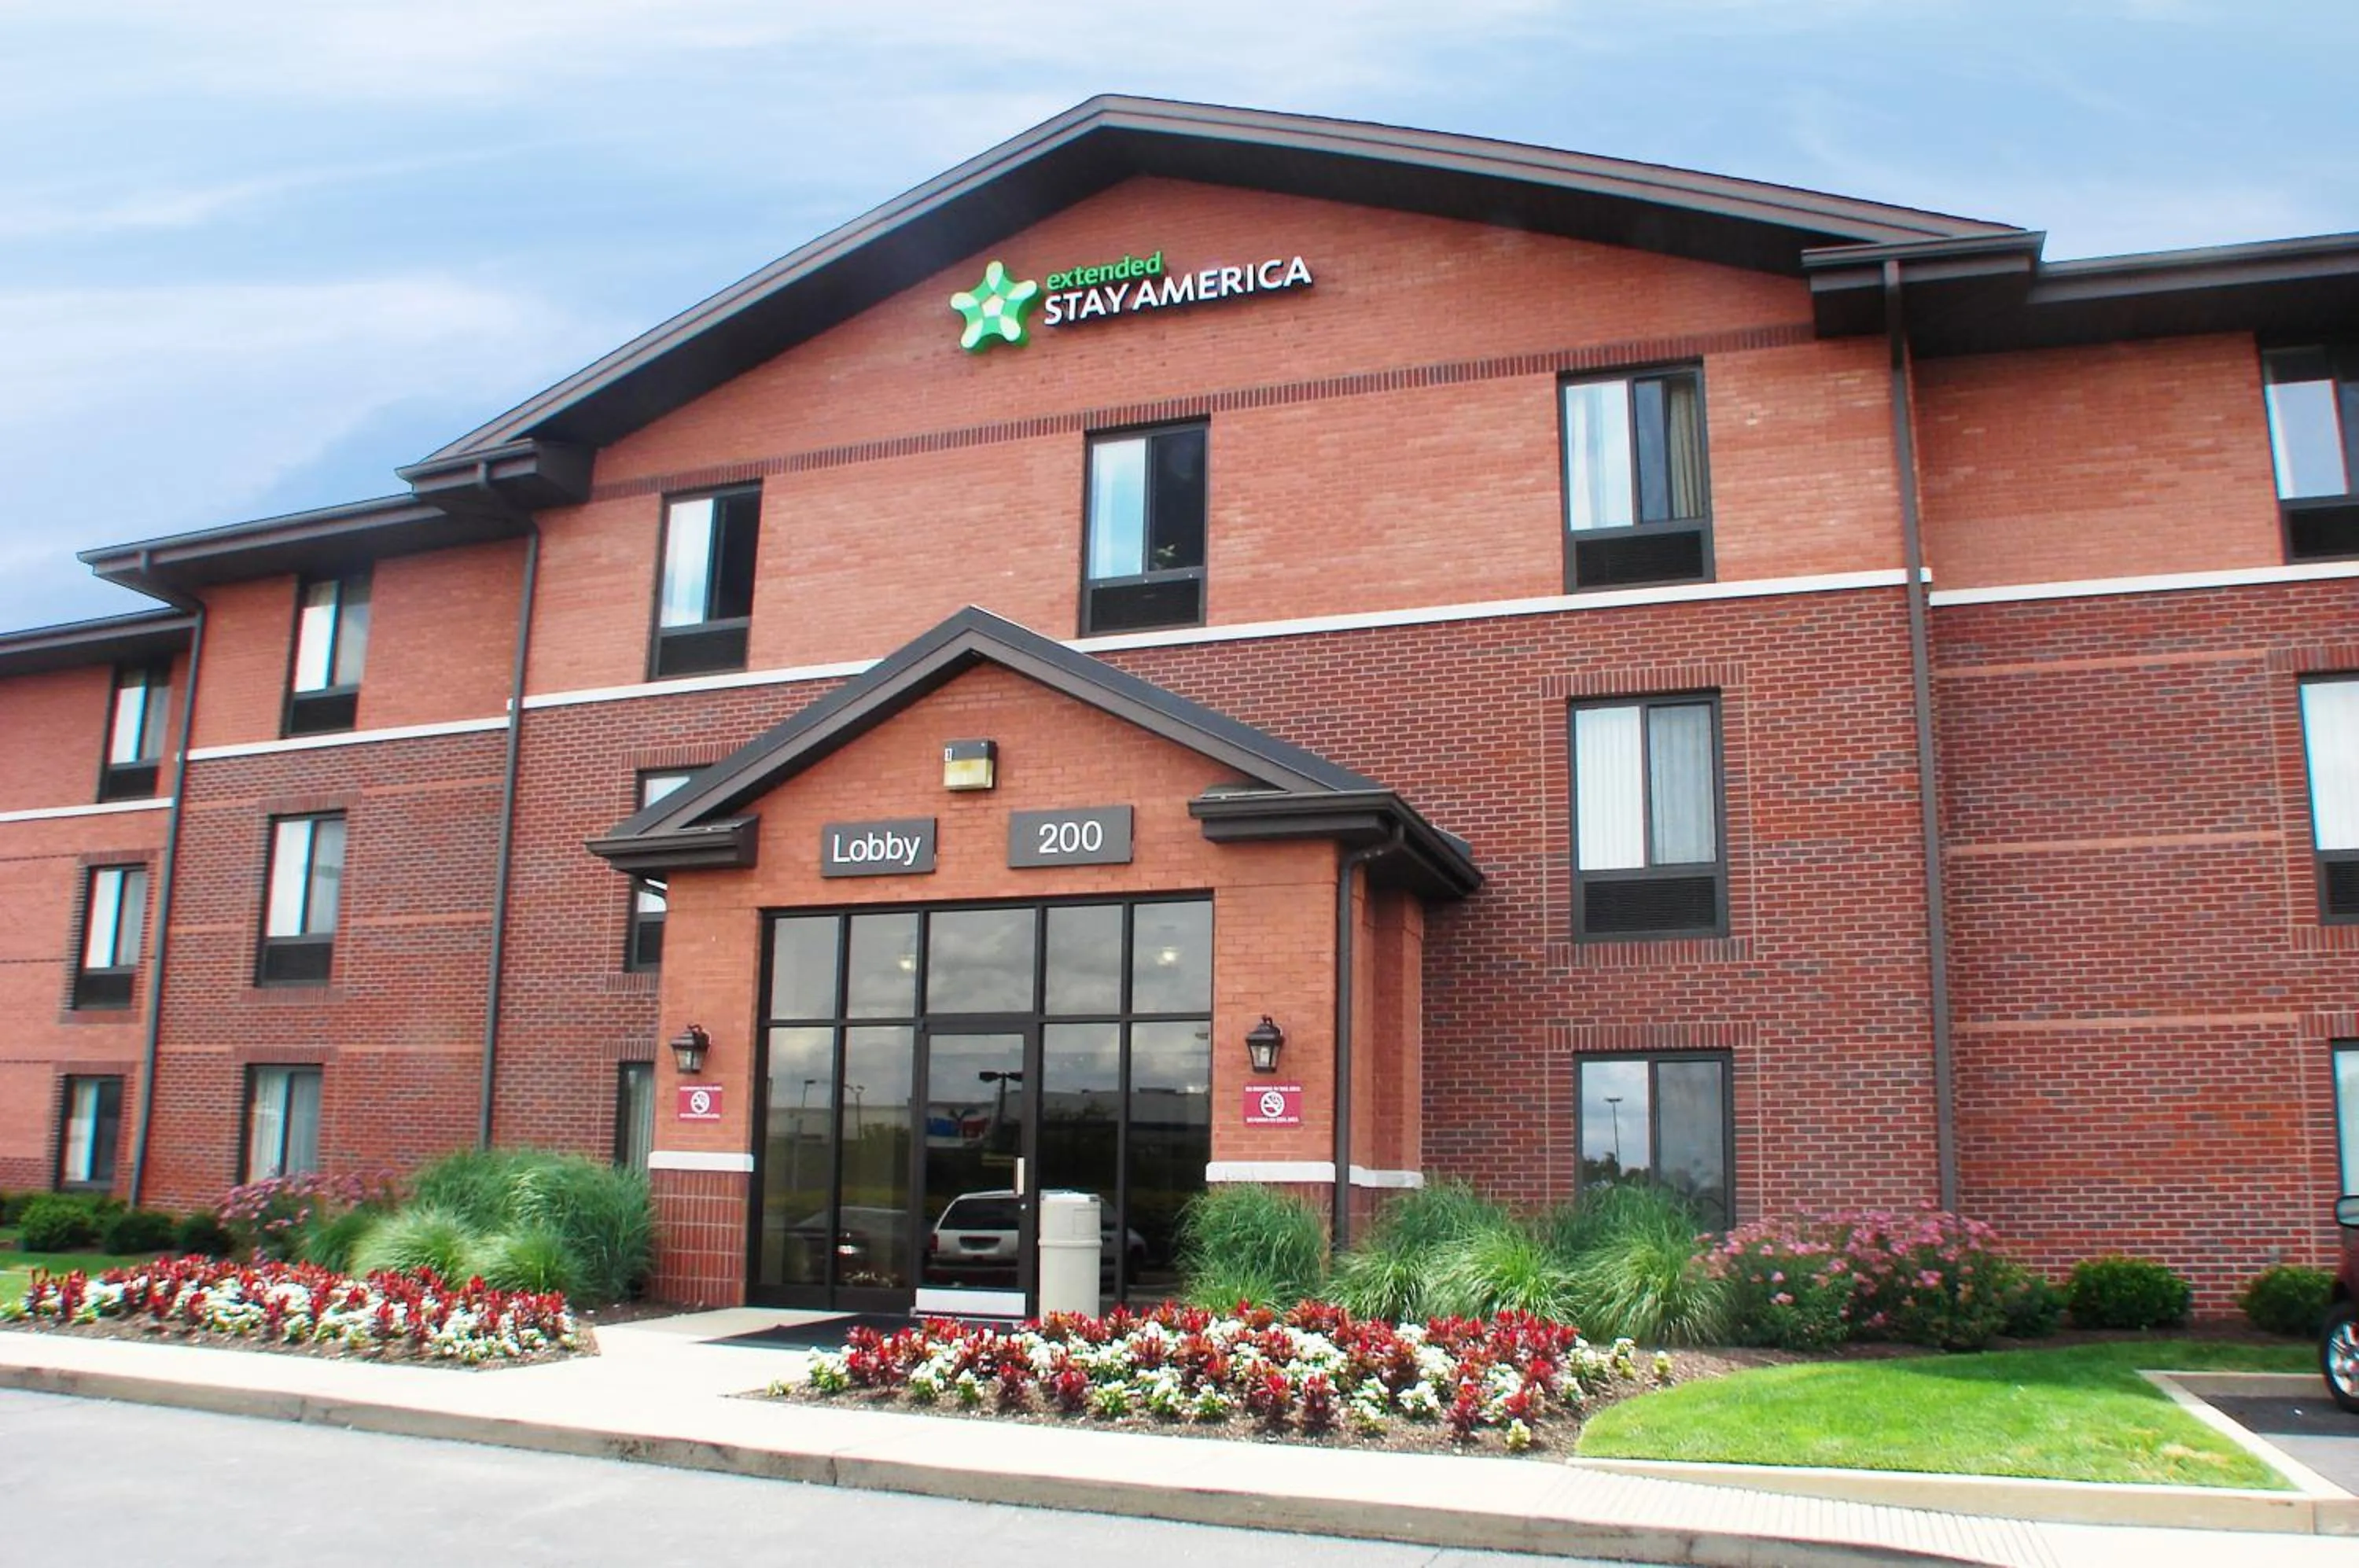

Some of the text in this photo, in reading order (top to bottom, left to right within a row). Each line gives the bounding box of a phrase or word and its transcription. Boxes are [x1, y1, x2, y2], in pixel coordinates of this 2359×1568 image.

[1047, 251, 1161, 291] extended
[1043, 256, 1312, 326] STAY AMERICA
[833, 831, 921, 866] Lobby
[1038, 820, 1102, 854] 200
